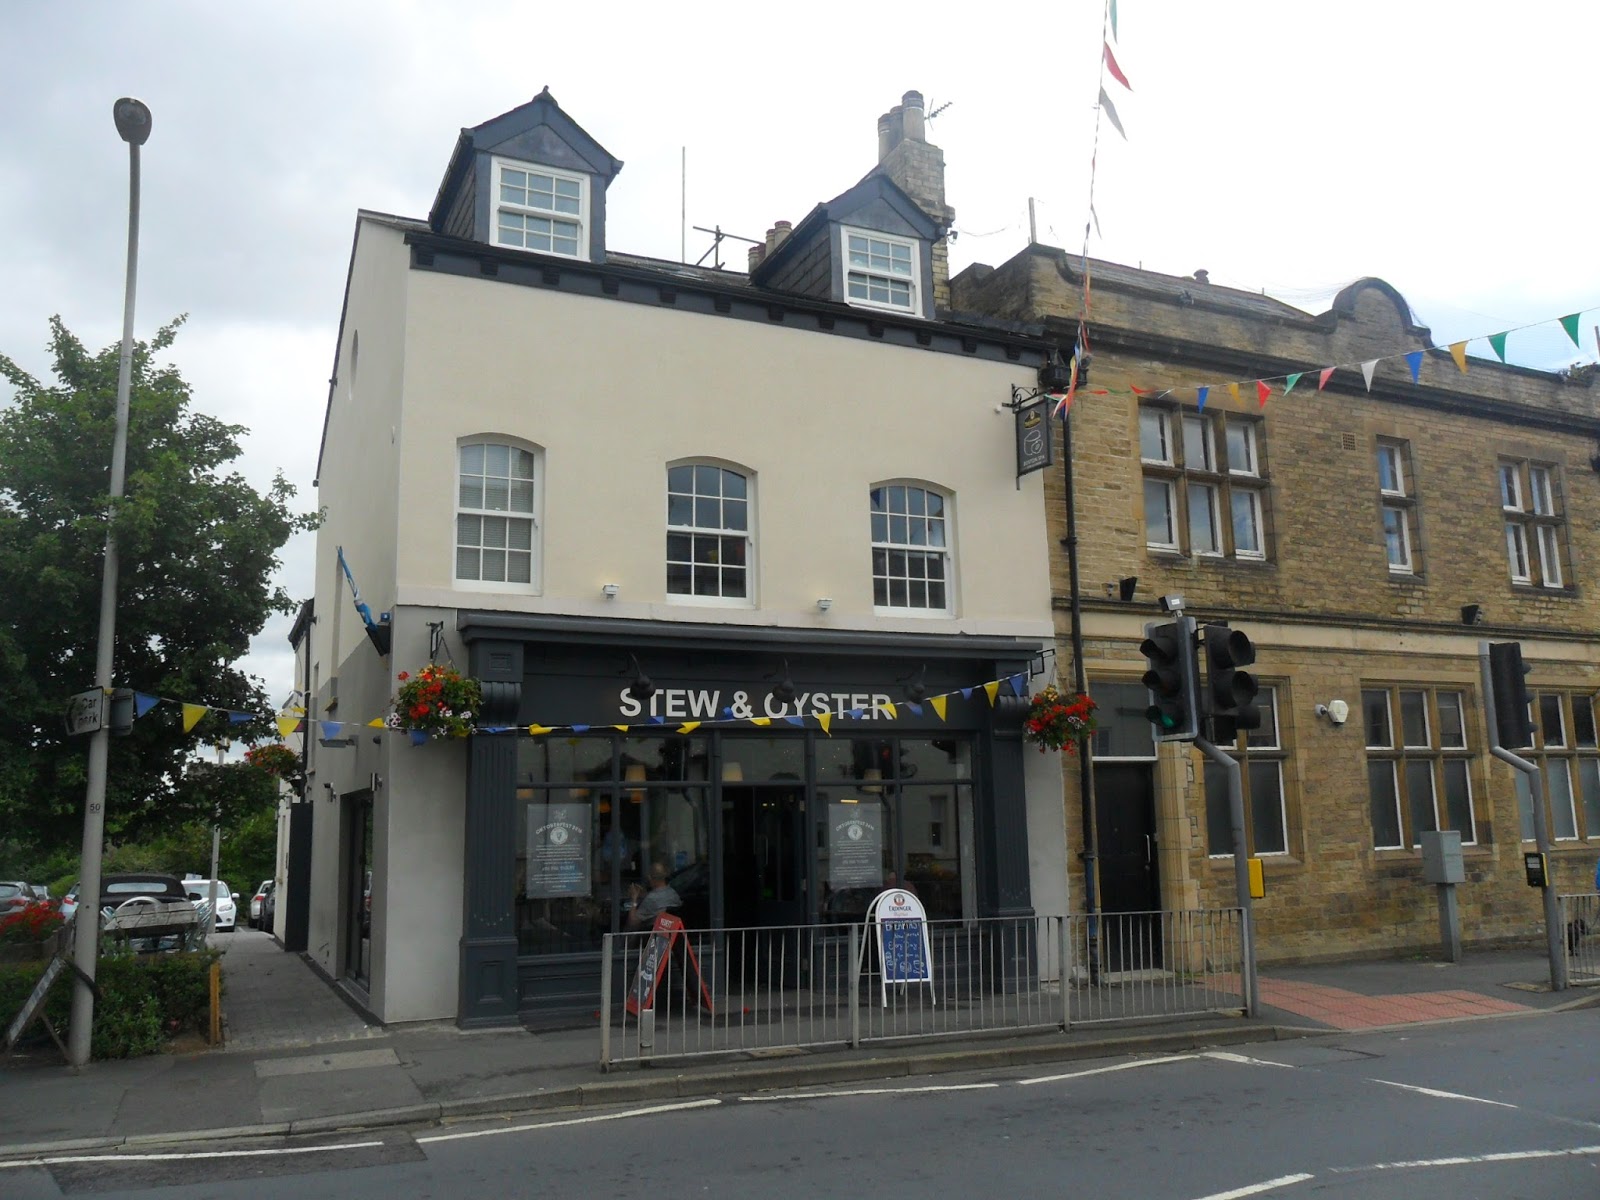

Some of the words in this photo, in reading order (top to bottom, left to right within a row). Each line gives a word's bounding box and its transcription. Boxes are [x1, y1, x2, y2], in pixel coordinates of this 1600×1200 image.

[619, 687, 720, 718] STEW
[732, 690, 753, 719] &
[763, 691, 894, 721] OYSTER
[90, 803, 101, 811] 50
